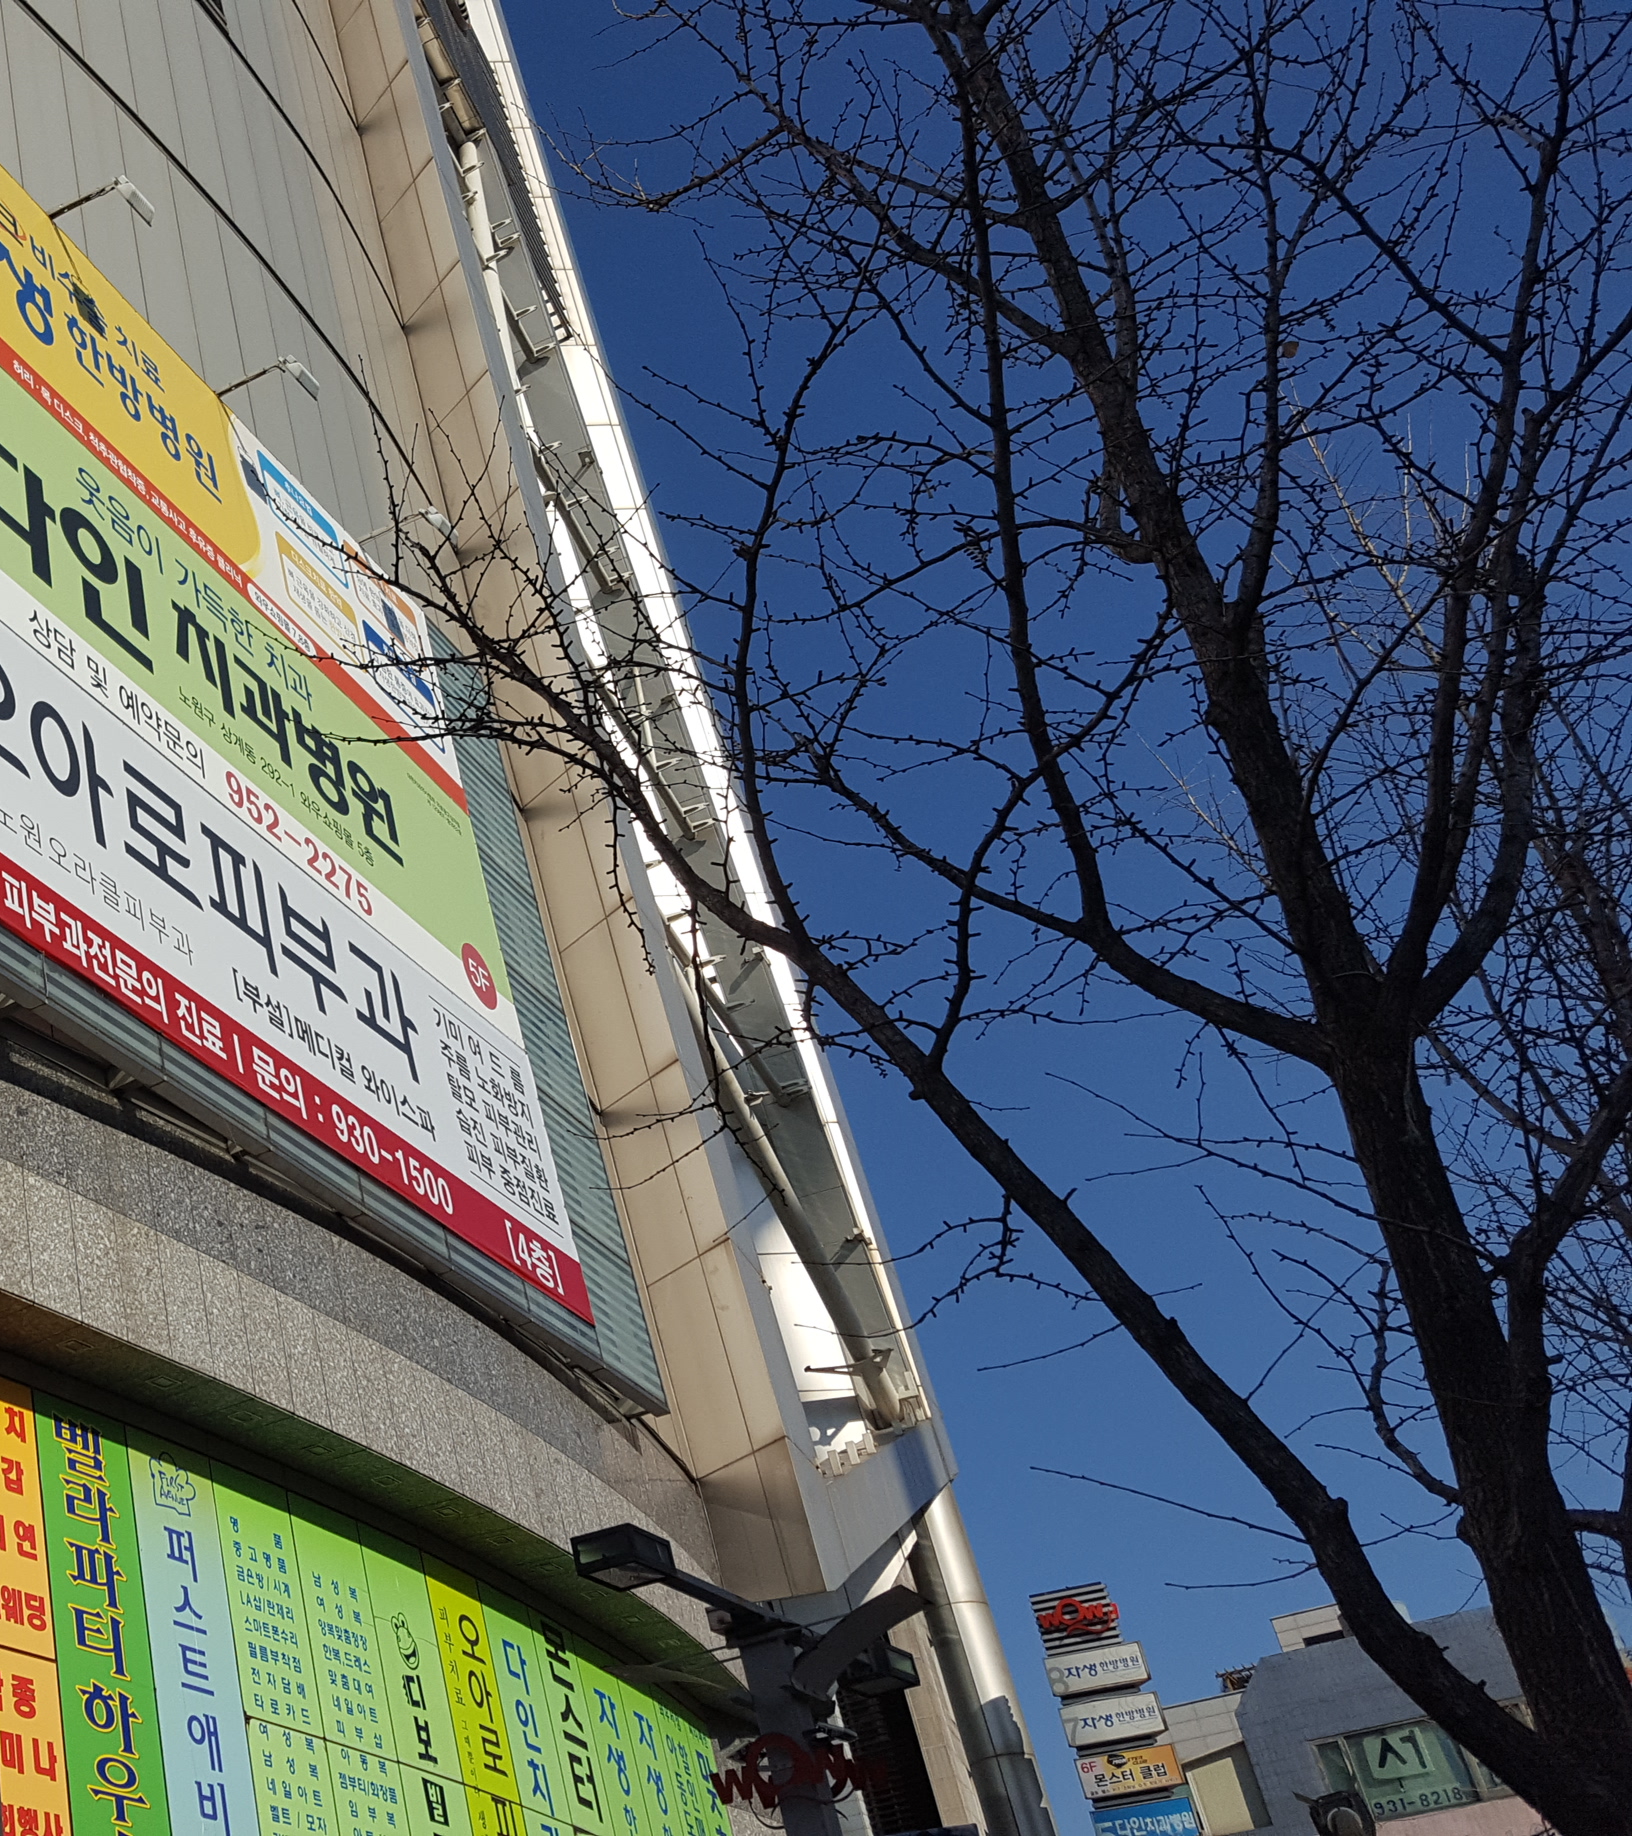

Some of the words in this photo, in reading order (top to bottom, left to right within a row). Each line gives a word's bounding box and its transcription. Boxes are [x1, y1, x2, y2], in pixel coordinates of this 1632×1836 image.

[114, 323, 166, 394] 치료
[63, 311, 223, 505] 한방병원
[75, 466, 164, 576] 웃음이
[174, 558, 255, 658] 가득한
[264, 640, 313, 712] 치과
[28, 609, 77, 671] 상담
[86, 655, 109, 699] 및
[118, 685, 206, 780] 예약문의
[225, 770, 373, 917] 952-2275
[170, 598, 405, 868] 치과병원
[179, 685, 216, 728] 노원구
[220, 722, 257, 765] 상계동
[260, 756, 296, 798] 292-1
[299, 791, 355, 850] 와우쇼핑몰
[466, 957, 492, 992] 5F
[1, 869, 169, 1026] 피부과전문의
[174, 990, 227, 1061] 진료
[331, 1108, 454, 1216] 930-1500
[433, 1007, 465, 1051] 기미
[361, 1063, 437, 1142] 와이스파
[439, 1038, 471, 1083] 주름
[474, 1065, 535, 1130] 노화방지
[446, 1071, 480, 1115] 탈모
[481, 1098, 542, 1162] 피부관리
[464, 1139, 496, 1181] 피부
[498, 1163, 560, 1226] 중점진료
[489, 1131, 551, 1194] 피부질환
[50, 1411, 152, 1836] 벨라파티하우
[244, 1615, 299, 1649] 스마트폰수리
[1064, 1663, 1098, 1680] 자생
[501, 1637, 558, 1836] 다인치
[1079, 1713, 1115, 1731] 자생
[1080, 1761, 1098, 1774] 6F
[1093, 1768, 1136, 1788] 몬스터
[1139, 1762, 1168, 1780] 클럽
[1373, 1787, 1464, 1816] 931-8218
